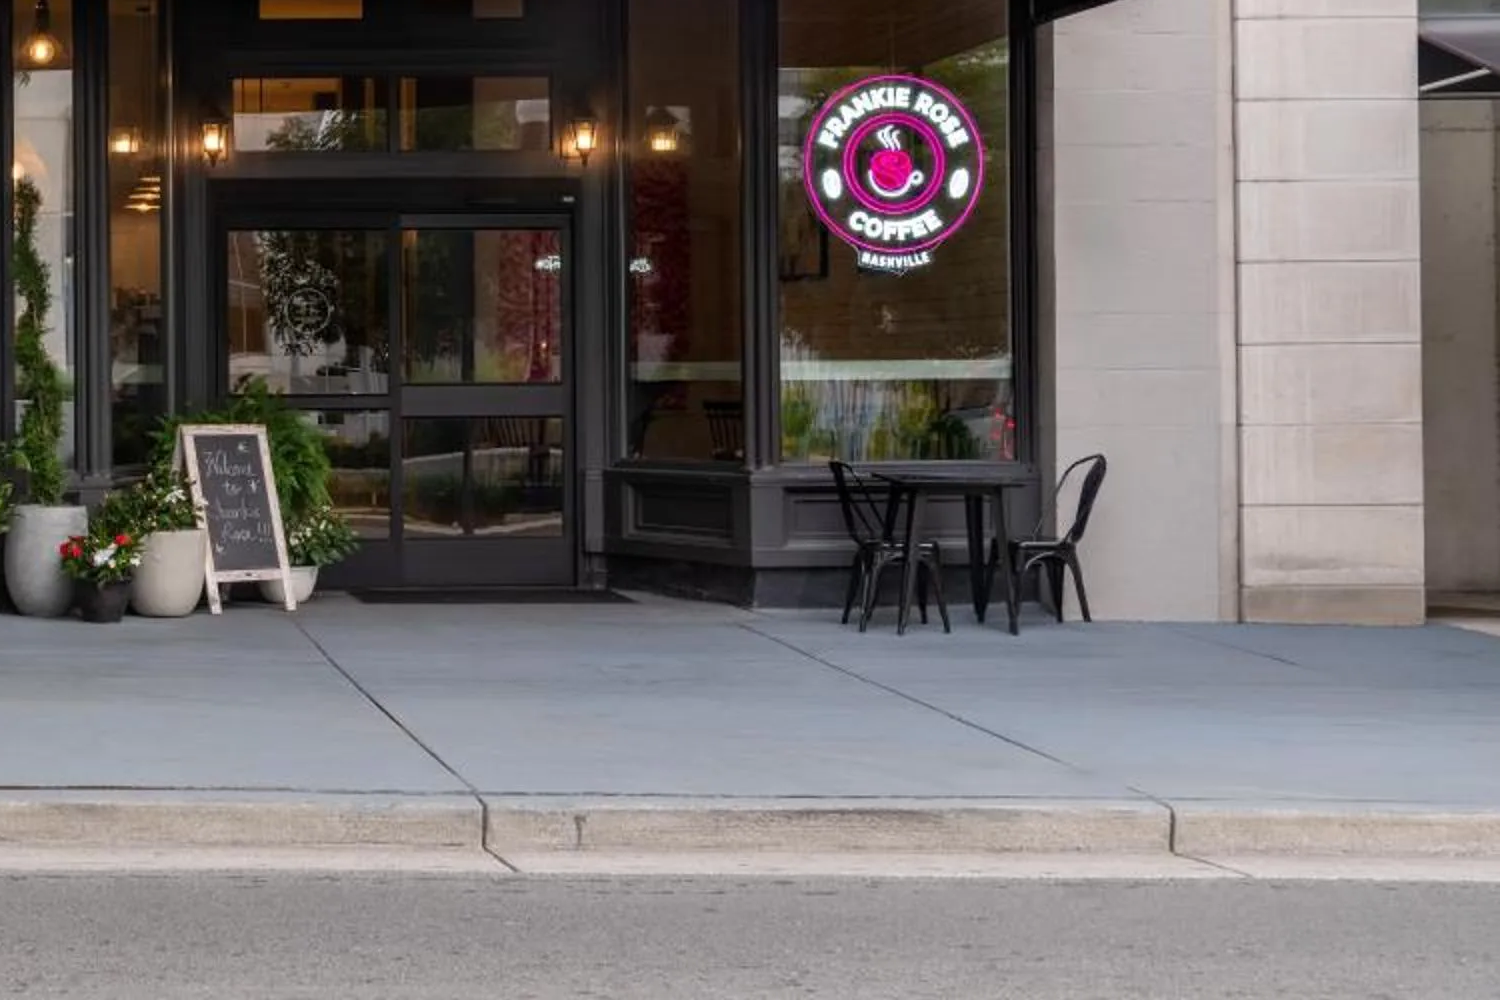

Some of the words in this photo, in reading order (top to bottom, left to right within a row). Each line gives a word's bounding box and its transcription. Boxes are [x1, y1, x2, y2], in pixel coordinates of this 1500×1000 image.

[817, 86, 912, 150] FRANKIE
[913, 91, 970, 149] ROSE
[848, 208, 944, 241] COFFEE
[860, 251, 931, 269] NASHVILLE
